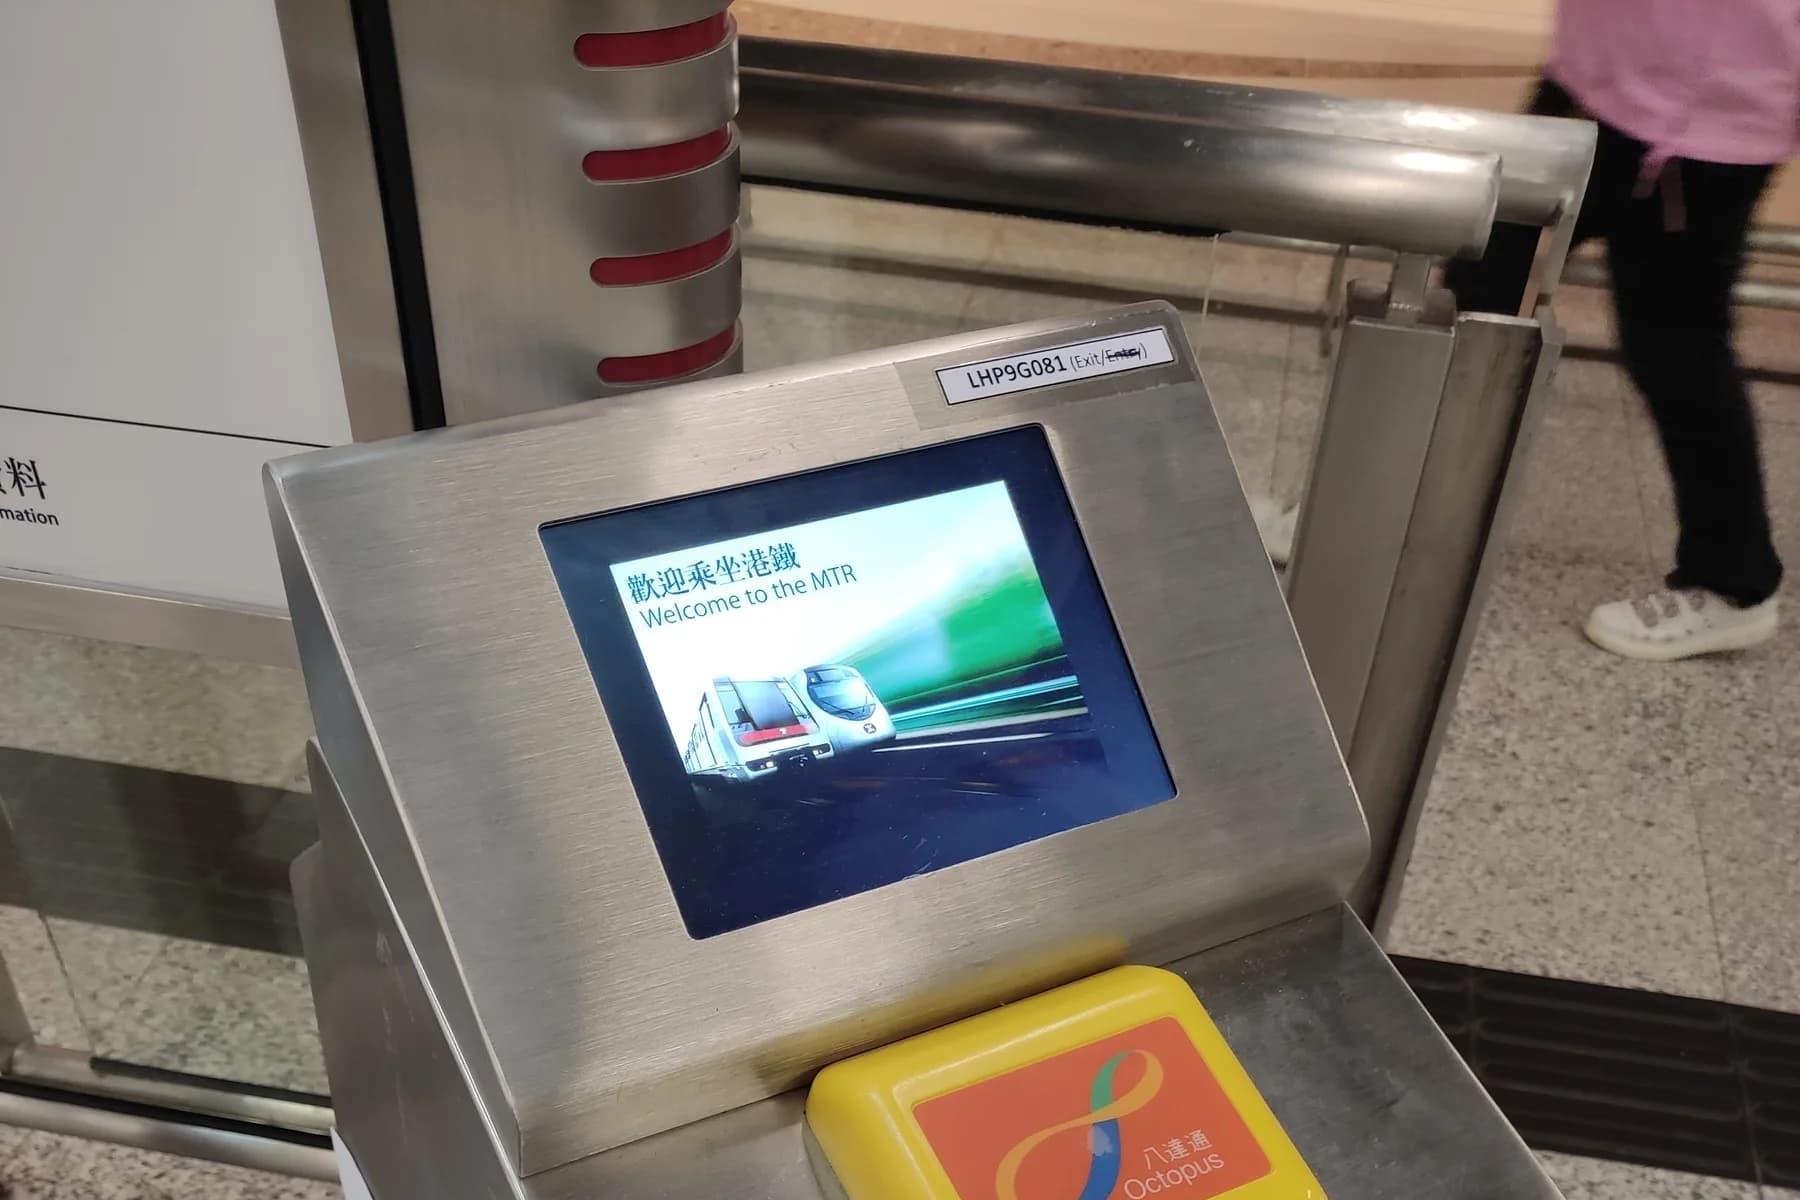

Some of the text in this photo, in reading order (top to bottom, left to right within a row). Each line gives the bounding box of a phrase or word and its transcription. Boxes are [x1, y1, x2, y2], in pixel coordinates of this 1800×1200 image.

[967, 342, 1148, 389] LHP9G081 (Exit/Enty)
[0, 456, 47, 500] 料
[626, 541, 801, 605] 歡迎乘坐港鐵
[639, 563, 858, 629] Welcome to the MTR
[1143, 1129, 1213, 1170] 八達通
[1123, 1153, 1225, 1200] Octopus
